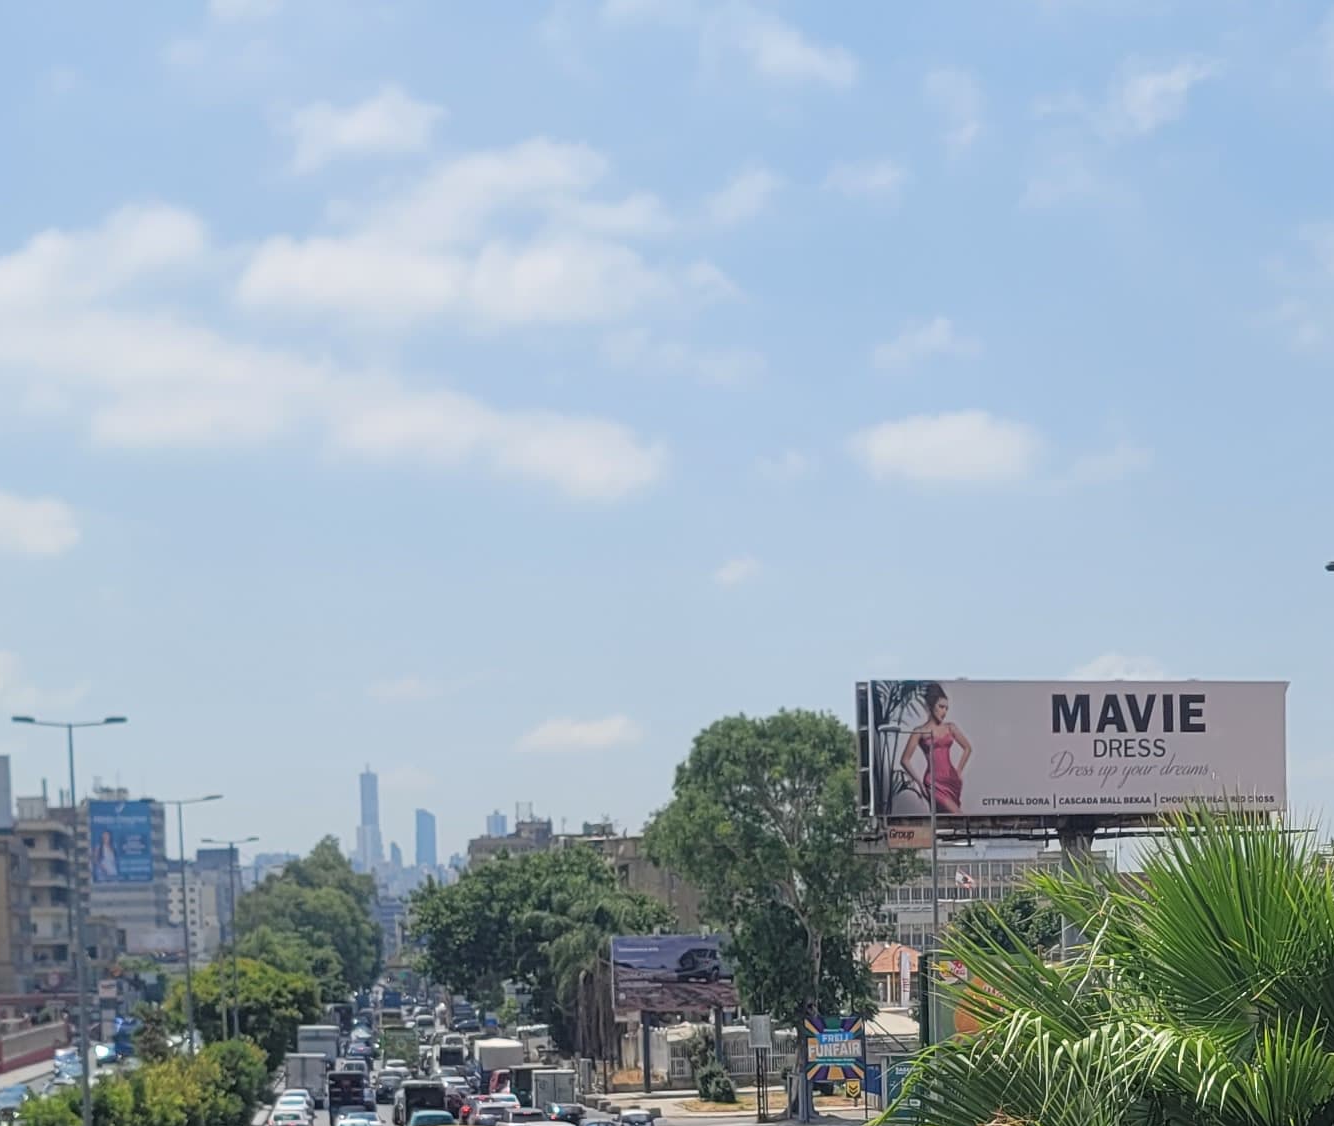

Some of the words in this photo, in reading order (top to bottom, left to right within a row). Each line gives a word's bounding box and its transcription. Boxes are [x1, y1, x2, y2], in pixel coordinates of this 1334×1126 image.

[1052, 694, 1206, 733] MAVIE
[1093, 738, 1166, 758] DRESS
[1050, 751, 1095, 779] Dress
[1098, 764, 1117, 788] up
[1117, 764, 1157, 789] your
[1160, 752, 1209, 776] dreams
[982, 797, 1025, 806] CITYMALL
[1025, 797, 1050, 805] DORA
[1059, 796, 1098, 805] CASCADA
[1100, 796, 1123, 804] MALL
[889, 828, 915, 840] Group
[808, 1040, 862, 1061] FUNFAIR
